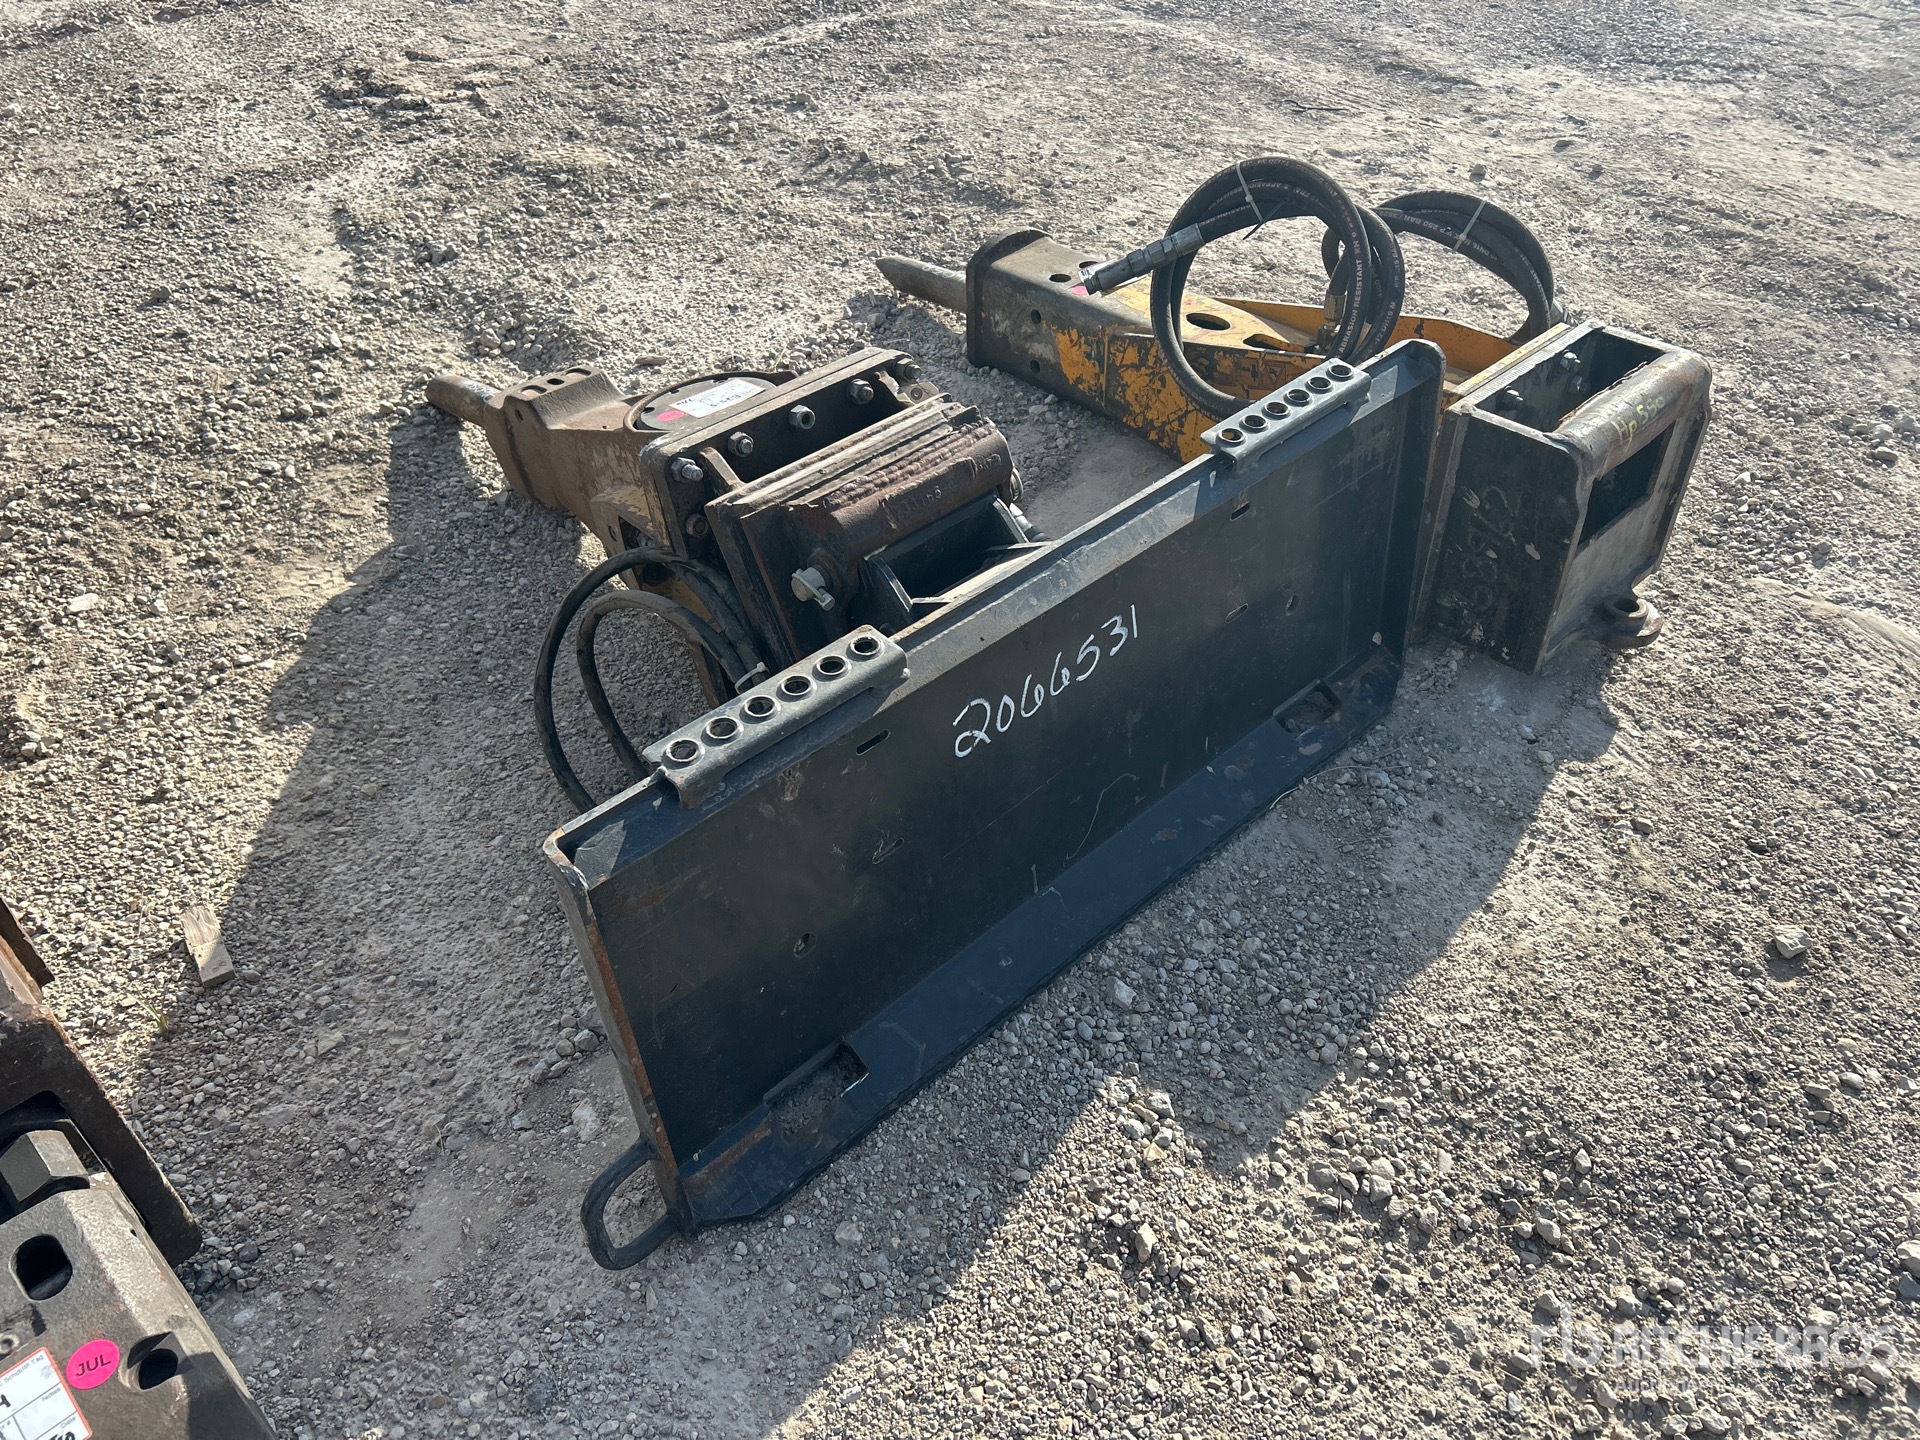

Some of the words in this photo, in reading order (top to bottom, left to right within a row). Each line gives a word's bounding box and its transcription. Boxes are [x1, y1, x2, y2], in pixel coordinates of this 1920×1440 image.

[1404, 215, 1422, 225] BAR
[1423, 220, 1439, 230] 250
[1339, 308, 1359, 353] ABRASION
[1353, 259, 1363, 307] RESISTANT
[952, 604, 1139, 758] 2066531
[76, 1354, 112, 1377] JUL
